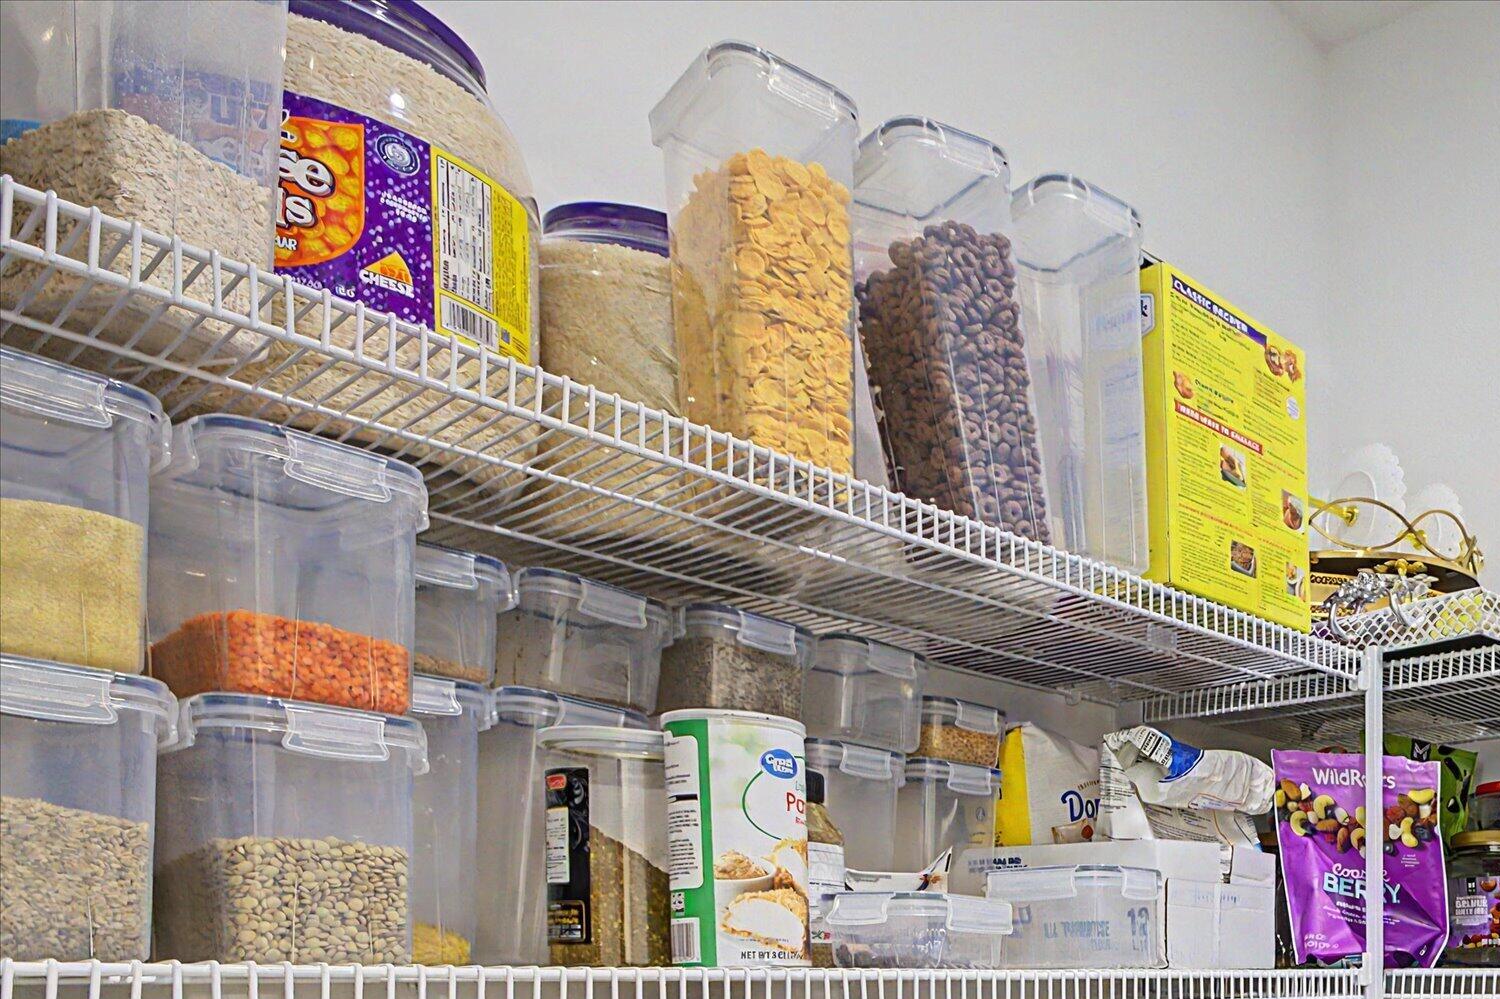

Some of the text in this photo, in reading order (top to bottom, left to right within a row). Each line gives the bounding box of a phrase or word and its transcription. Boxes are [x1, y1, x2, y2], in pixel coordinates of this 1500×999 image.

[359, 269, 415, 299] CHEESE
[1312, 766, 1396, 790] WildRts
[1323, 872, 1400, 904] BERY
